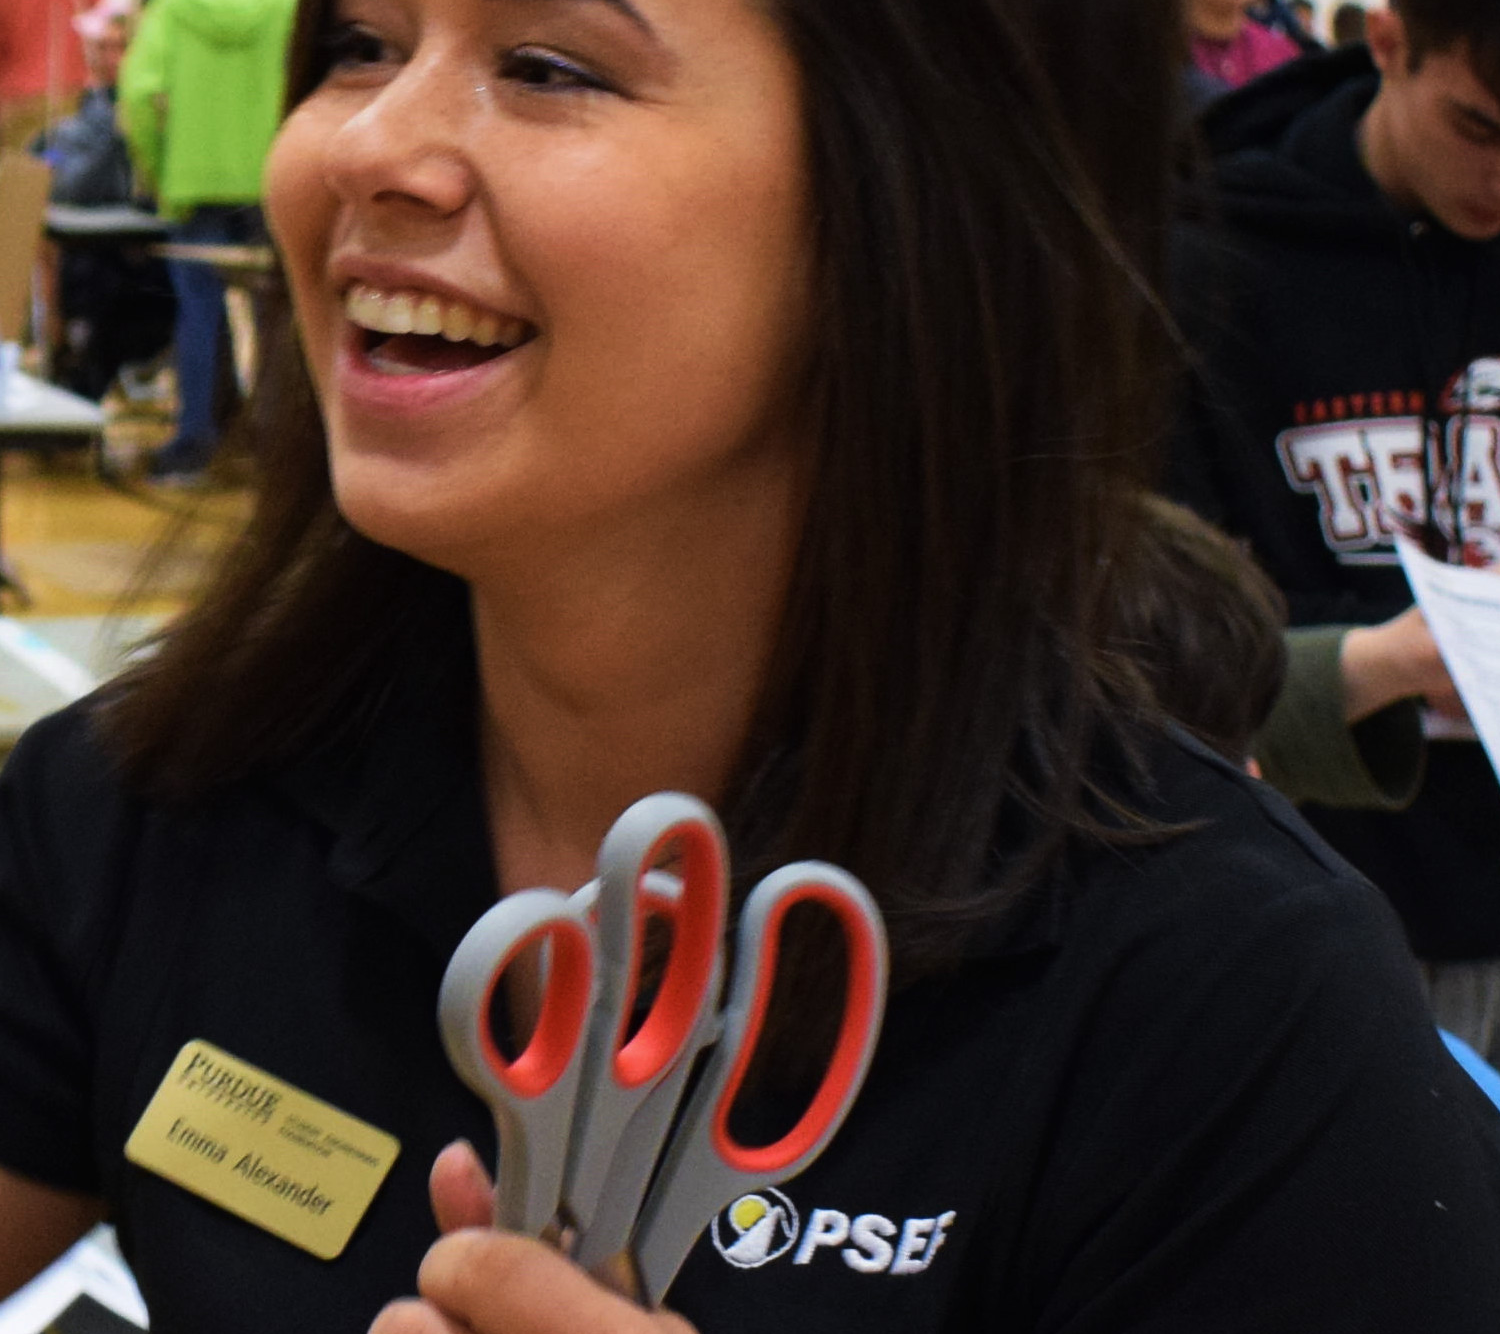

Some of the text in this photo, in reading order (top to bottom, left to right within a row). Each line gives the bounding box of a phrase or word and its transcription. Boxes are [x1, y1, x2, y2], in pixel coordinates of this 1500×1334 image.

[182, 1052, 281, 1109] PURDUE
[166, 1117, 227, 1163] Emma
[233, 1152, 335, 1216] Alexander
